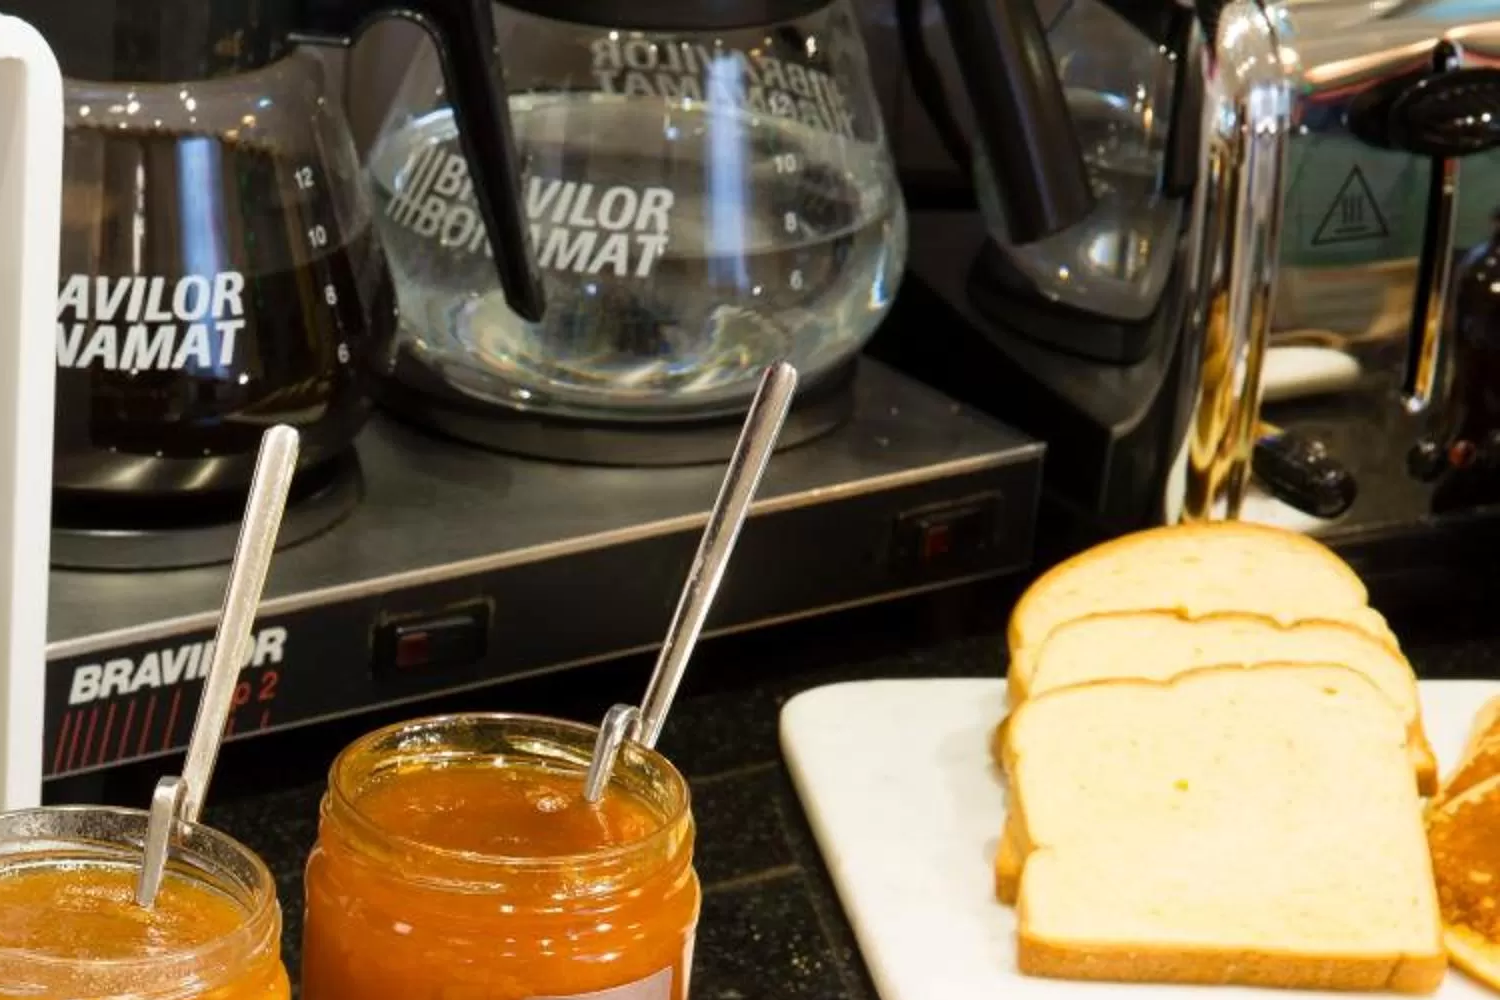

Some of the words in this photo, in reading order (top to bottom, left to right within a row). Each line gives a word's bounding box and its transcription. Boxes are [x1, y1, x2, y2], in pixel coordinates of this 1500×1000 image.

[774, 153, 797, 174] 10
[293, 165, 315, 190] 12
[308, 223, 328, 249] 10
[337, 342, 350, 364] 6
[258, 670, 278, 701] 2
